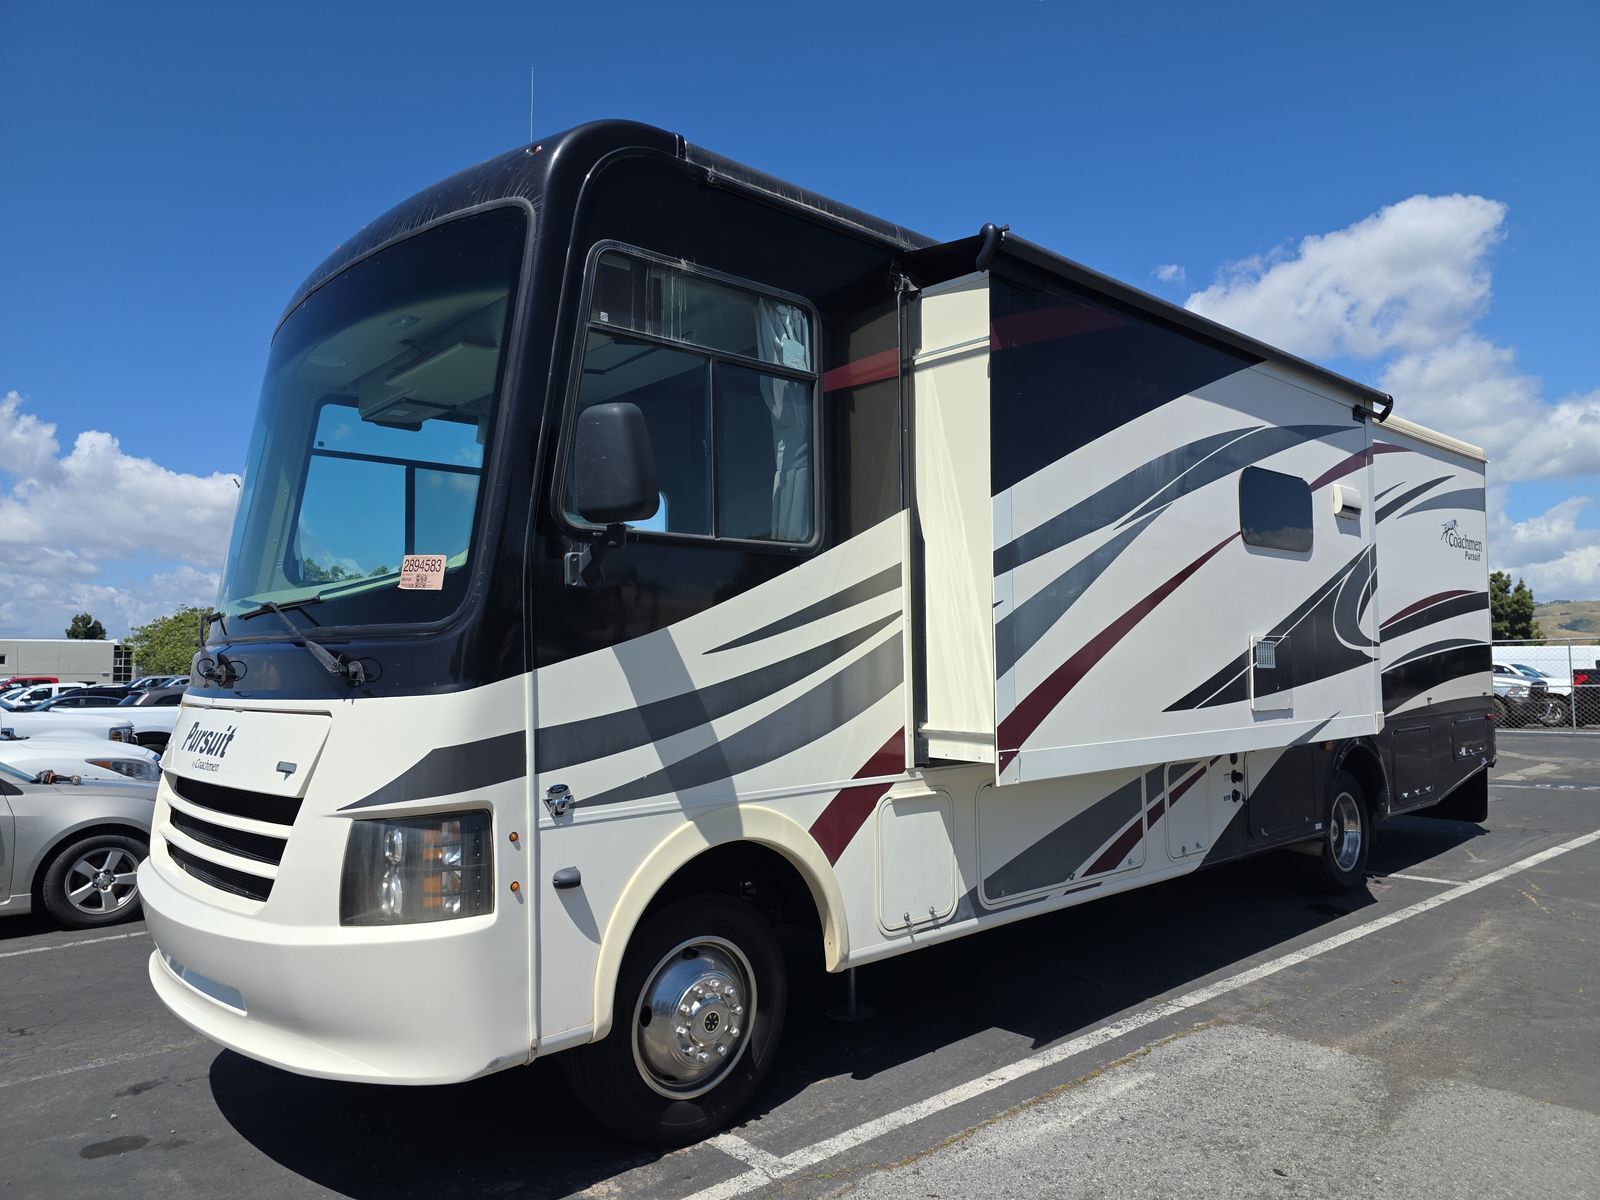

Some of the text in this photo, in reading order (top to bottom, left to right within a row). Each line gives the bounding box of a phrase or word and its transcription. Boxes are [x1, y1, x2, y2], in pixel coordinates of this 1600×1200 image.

[1448, 533, 1483, 552] Coachmen
[1464, 550, 1481, 562] Pursuit
[403, 559, 442, 572] 2894583
[181, 722, 237, 758] Pursuit
[195, 758, 220, 772] Coachmen
